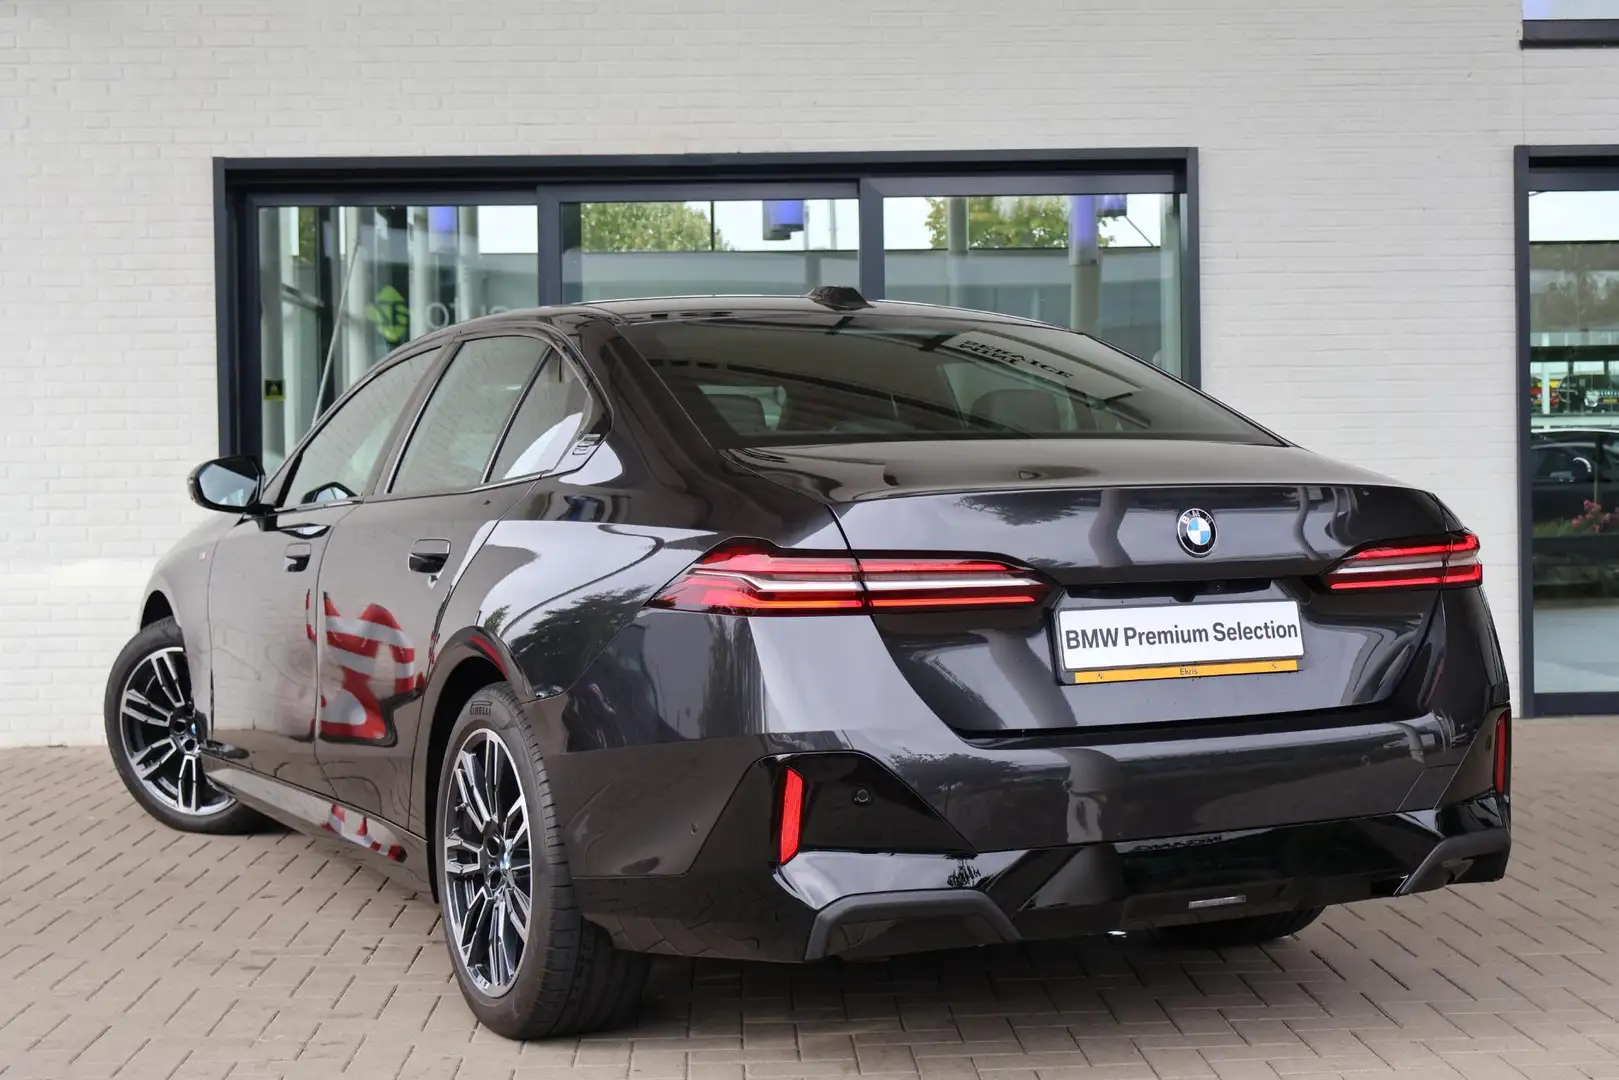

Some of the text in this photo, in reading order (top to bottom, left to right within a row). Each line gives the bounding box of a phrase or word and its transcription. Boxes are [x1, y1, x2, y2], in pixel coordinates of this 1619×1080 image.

[1181, 510, 1212, 525] BMW
[1065, 620, 1298, 650] BMW Premium Selection
[1179, 667, 1199, 676] Ekris
[469, 700, 493, 716] PIRELLI
